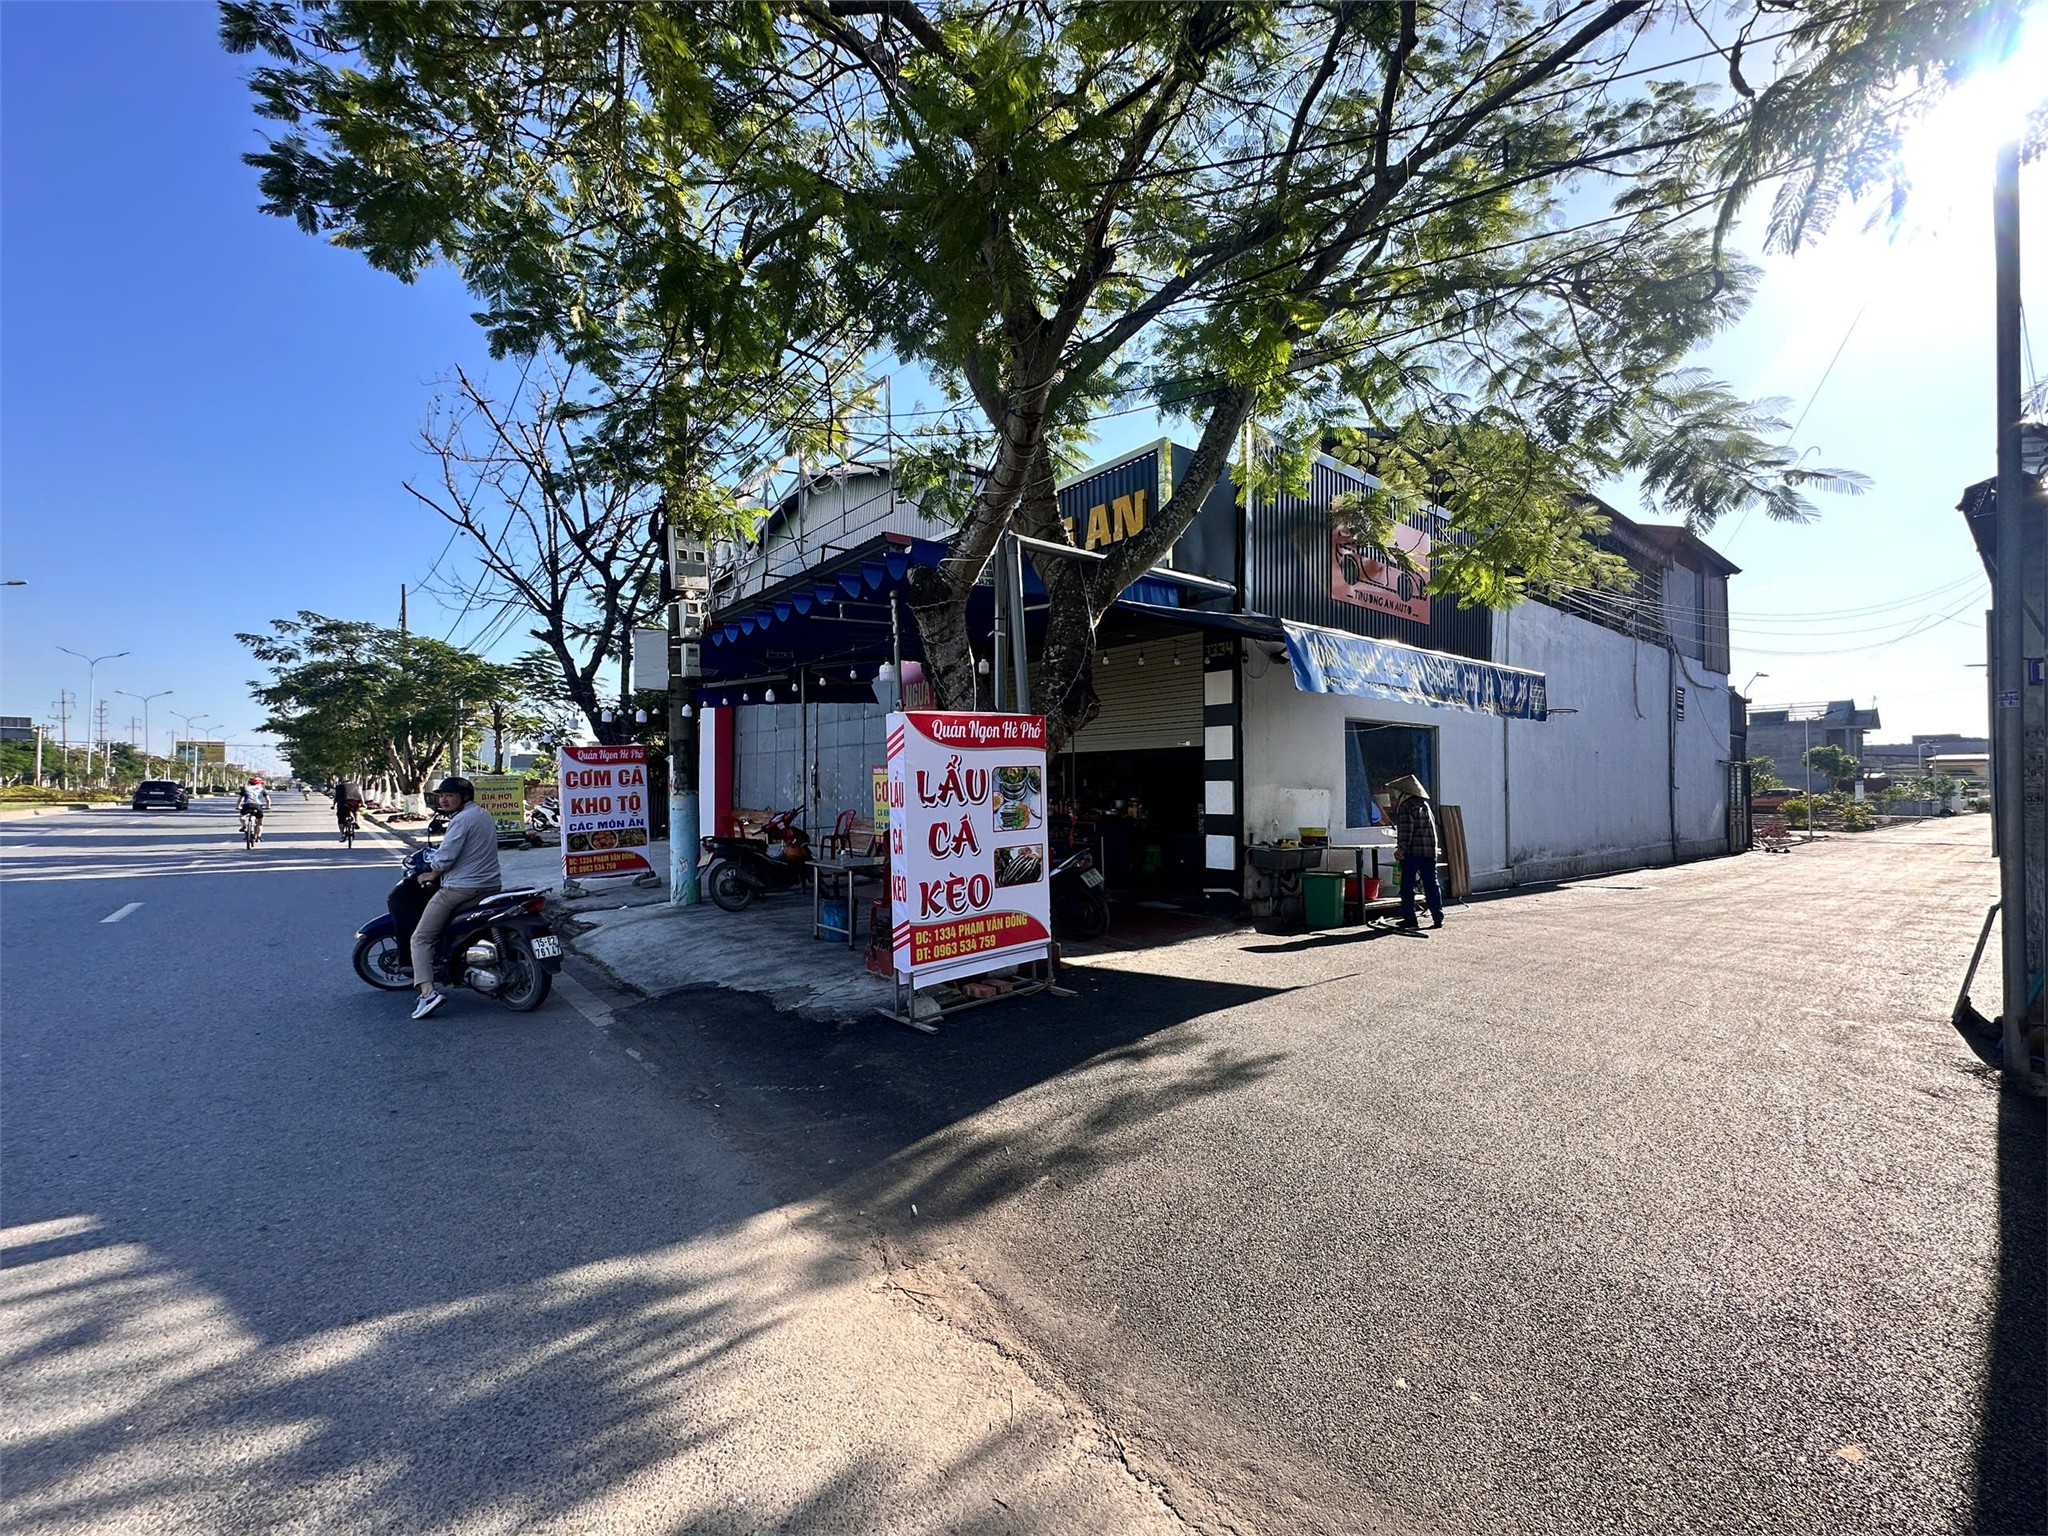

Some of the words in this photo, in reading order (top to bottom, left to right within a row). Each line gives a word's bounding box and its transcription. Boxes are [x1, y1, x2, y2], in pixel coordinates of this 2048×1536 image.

[1085, 489, 1149, 551] AN
[1394, 602, 1412, 615] AUTO
[932, 719, 967, 740] Quán
[968, 720, 1000, 744] Ngon
[1002, 721, 1018, 739] Hè
[1020, 718, 1042, 739] Phố
[577, 750, 598, 762] Quán
[600, 749, 618, 763] Ngon
[630, 747, 645, 760] Phố
[565, 768, 612, 789] CƠM
[618, 765, 645, 787] CÁ
[890, 771, 904, 809] LẨU
[916, 754, 990, 807] LẨU
[481, 793, 495, 801] BIA
[570, 796, 613, 817] KHO
[617, 791, 642, 816] TỘ
[569, 821, 594, 832] CÁC
[597, 819, 625, 830] MÓN
[628, 817, 645, 827] ĂN
[893, 823, 904, 856] CÁ
[928, 814, 981, 859] CÁ
[892, 869, 907, 903] KÈO
[919, 872, 993, 918] KÈO
[915, 931, 932, 946] ĐC:
[934, 927, 957, 942] 1334
[958, 922, 985, 938] PHẠM
[986, 916, 1004, 932] VĂN
[1005, 911, 1028, 929] ĐỒNG
[916, 947, 931, 962] ĐT:
[933, 942, 958, 958] 0963
[960, 938, 977, 953] 534
[979, 934, 996, 949] 759
